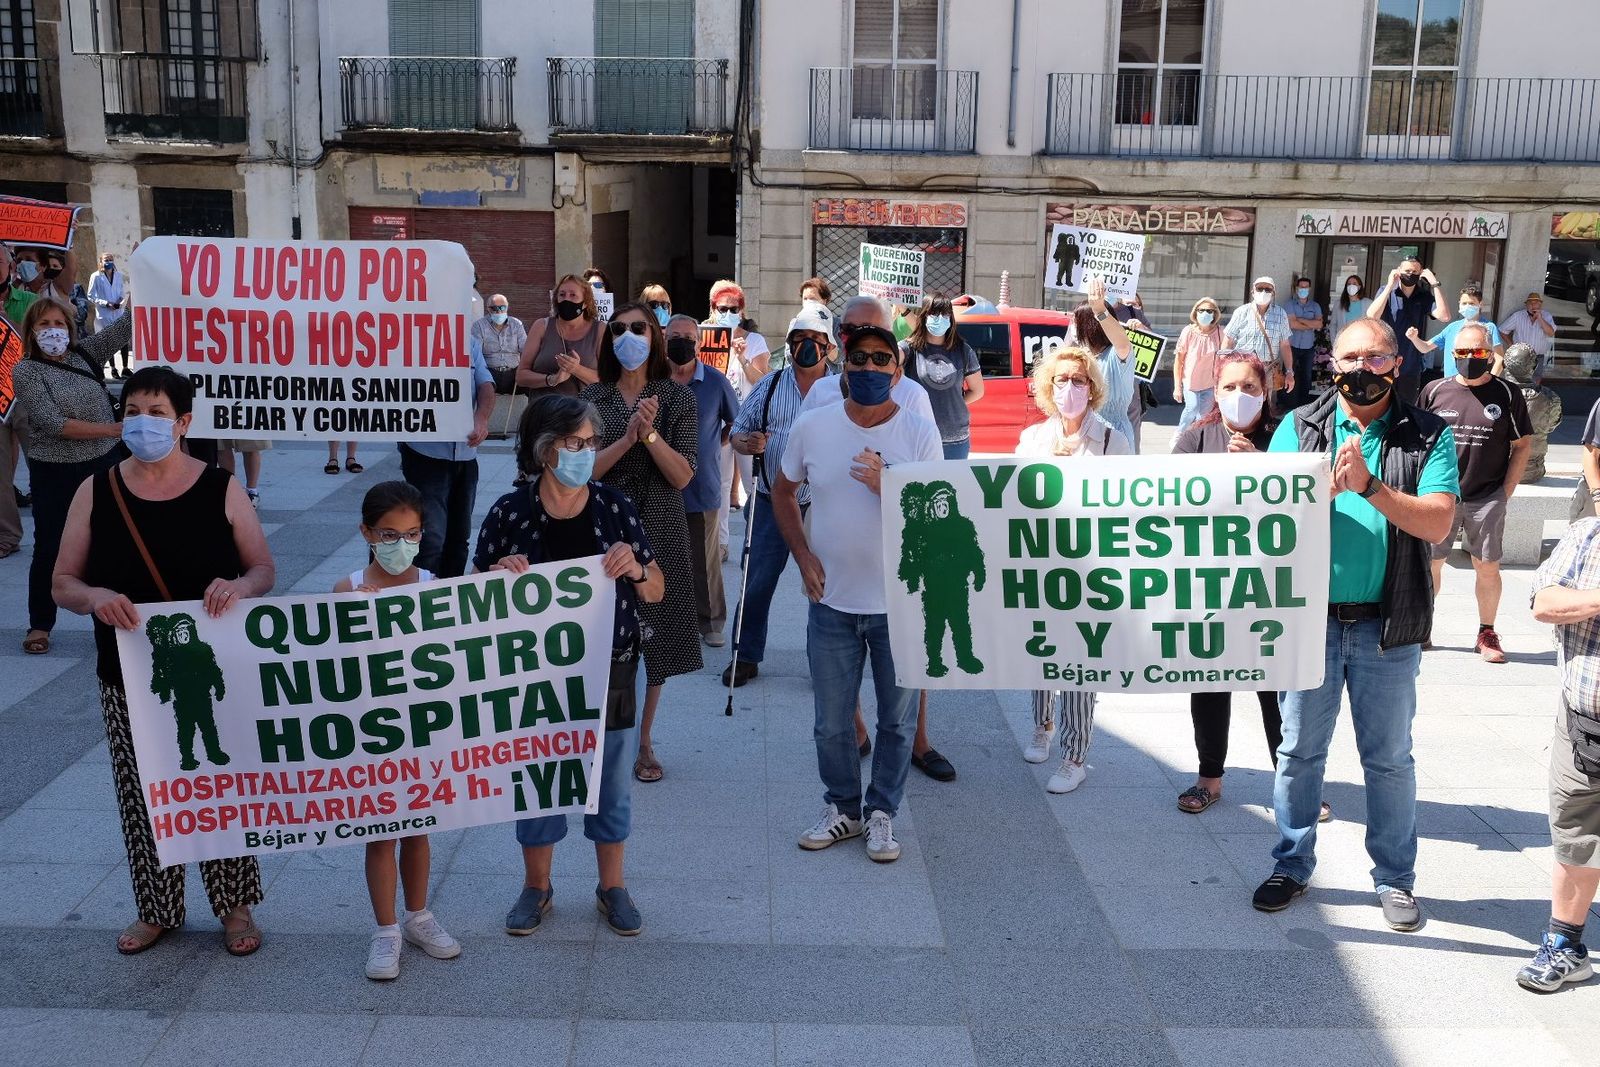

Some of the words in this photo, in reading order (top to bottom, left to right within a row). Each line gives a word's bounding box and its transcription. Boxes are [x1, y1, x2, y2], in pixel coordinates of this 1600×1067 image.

[813, 202, 966, 226] LEGUMBRES
[1073, 207, 1228, 232] PANADERÍA
[1339, 213, 1464, 234] ALIMENTACIÓN
[6, 223, 57, 239] HOSPITAL
[1078, 231, 1097, 244] YO
[1099, 239, 1124, 249] LUCHO
[1124, 242, 1140, 251] POR
[872, 258, 920, 275] NUESTRO
[873, 247, 922, 262] QUEREMOS
[1081, 259, 1133, 275] HOSPITAL
[1084, 246, 1134, 262] NUESTRO
[177, 243, 221, 298] YO
[233, 246, 346, 302] LUCHO
[358, 247, 427, 302] POR
[871, 270, 920, 287] HOSPITAL
[133, 305, 295, 367] NUESTRO
[308, 309, 470, 368] HOSPITAL
[189, 373, 346, 402] PLATAFORMA
[352, 377, 460, 403] SANIDAD
[214, 401, 287, 431] BÉJAR
[292, 407, 307, 431] Y
[313, 407, 437, 433] COMARCA
[970, 462, 1064, 510] YO
[1082, 476, 1212, 507] LUCHO
[1235, 474, 1317, 505] POR
[1008, 513, 1297, 559] NUESTRO
[1001, 565, 1307, 611] HOSPITAL
[245, 565, 594, 655] QUEREMOS
[1152, 612, 1225, 660] TÚ
[259, 621, 586, 707] NUESTRO
[1042, 662, 1111, 686] Béjar
[1120, 671, 1134, 688] y
[1143, 664, 1266, 683] Comarca
[256, 675, 601, 764] HOSPITAL
[149, 757, 421, 808] HOSPITALIZACIÓN
[430, 759, 443, 782] y
[452, 729, 598, 774] URGENCIA
[154, 790, 398, 841] HOSPITALARIAS
[407, 782, 457, 811] 24
[467, 774, 503, 803] h.
[512, 757, 595, 813] ¡YA
[245, 827, 307, 849] Béjar
[314, 827, 327, 846] y
[334, 813, 438, 840] Comarca
